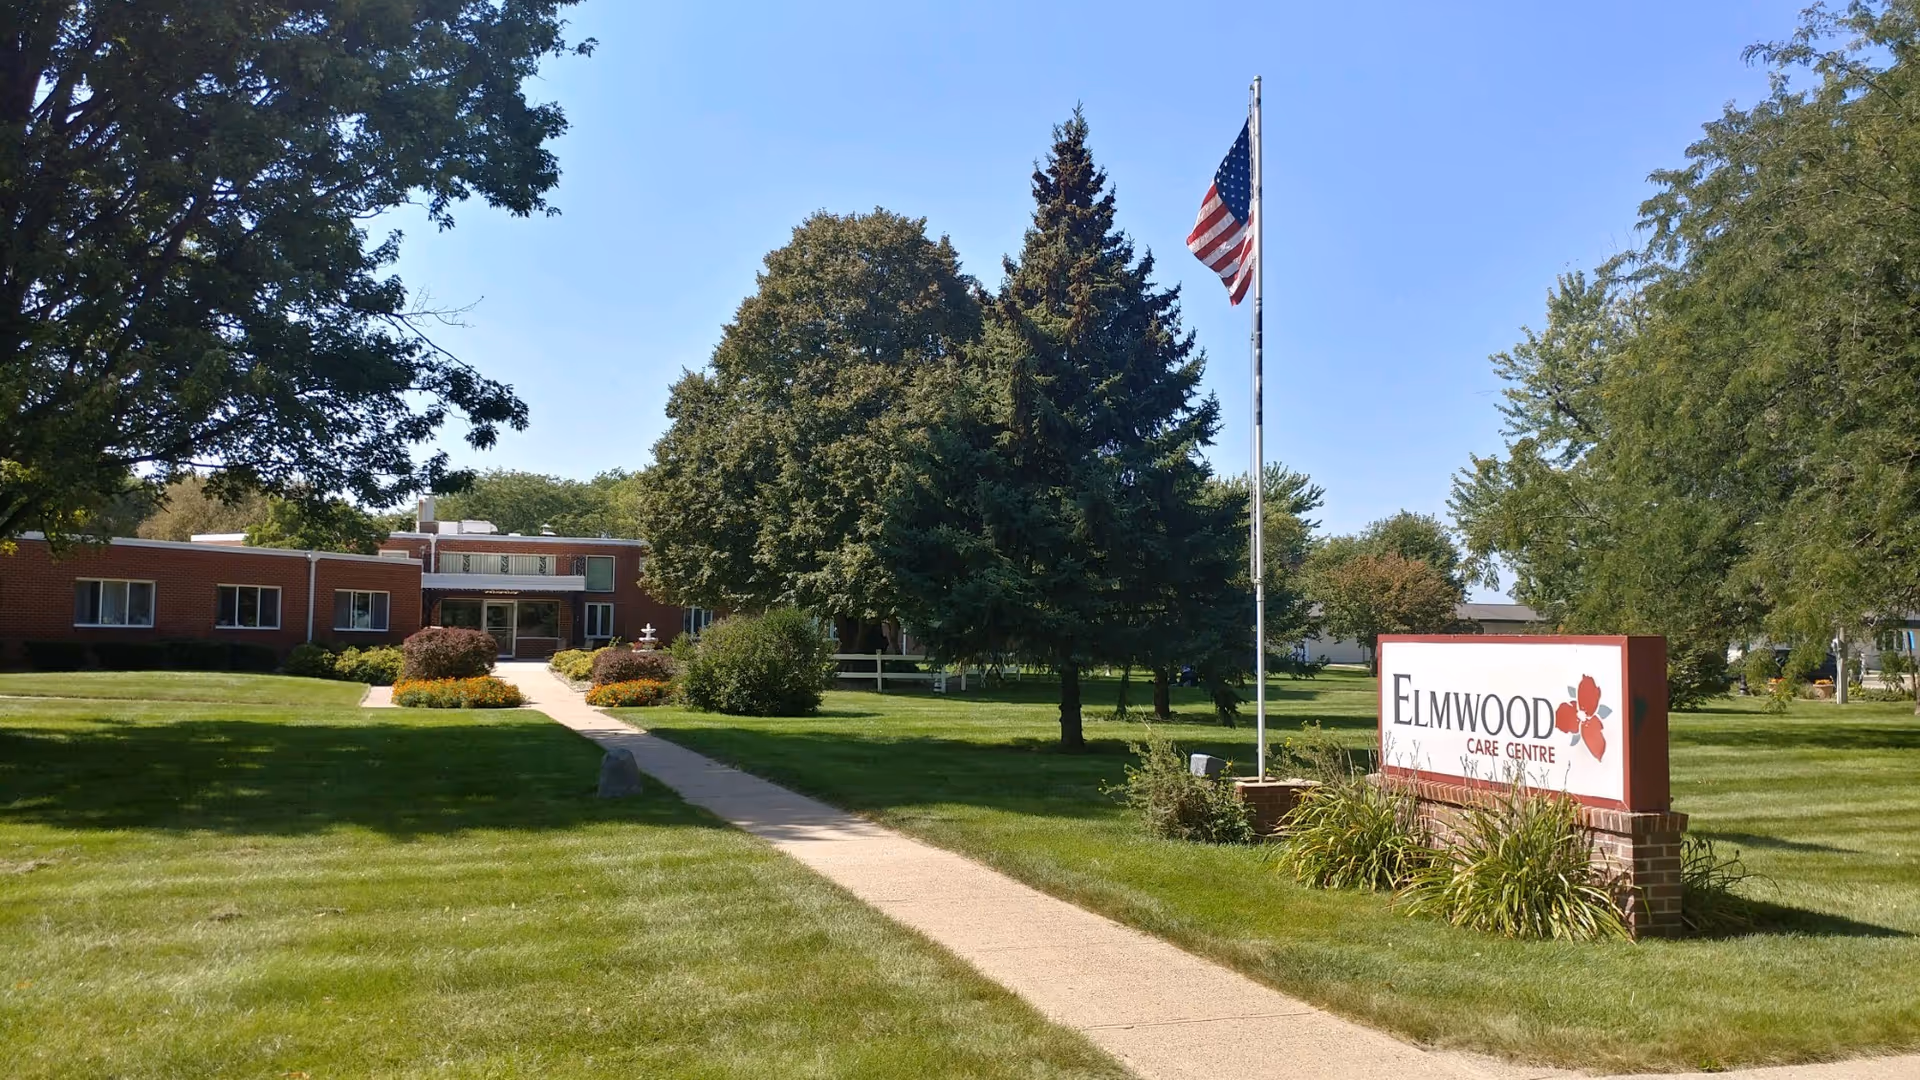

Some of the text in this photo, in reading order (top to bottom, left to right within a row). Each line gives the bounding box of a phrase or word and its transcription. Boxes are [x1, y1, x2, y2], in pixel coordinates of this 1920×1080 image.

[1393, 673, 1554, 739] ELMWOOD
[1467, 738, 1555, 763] CARE CENTRE
